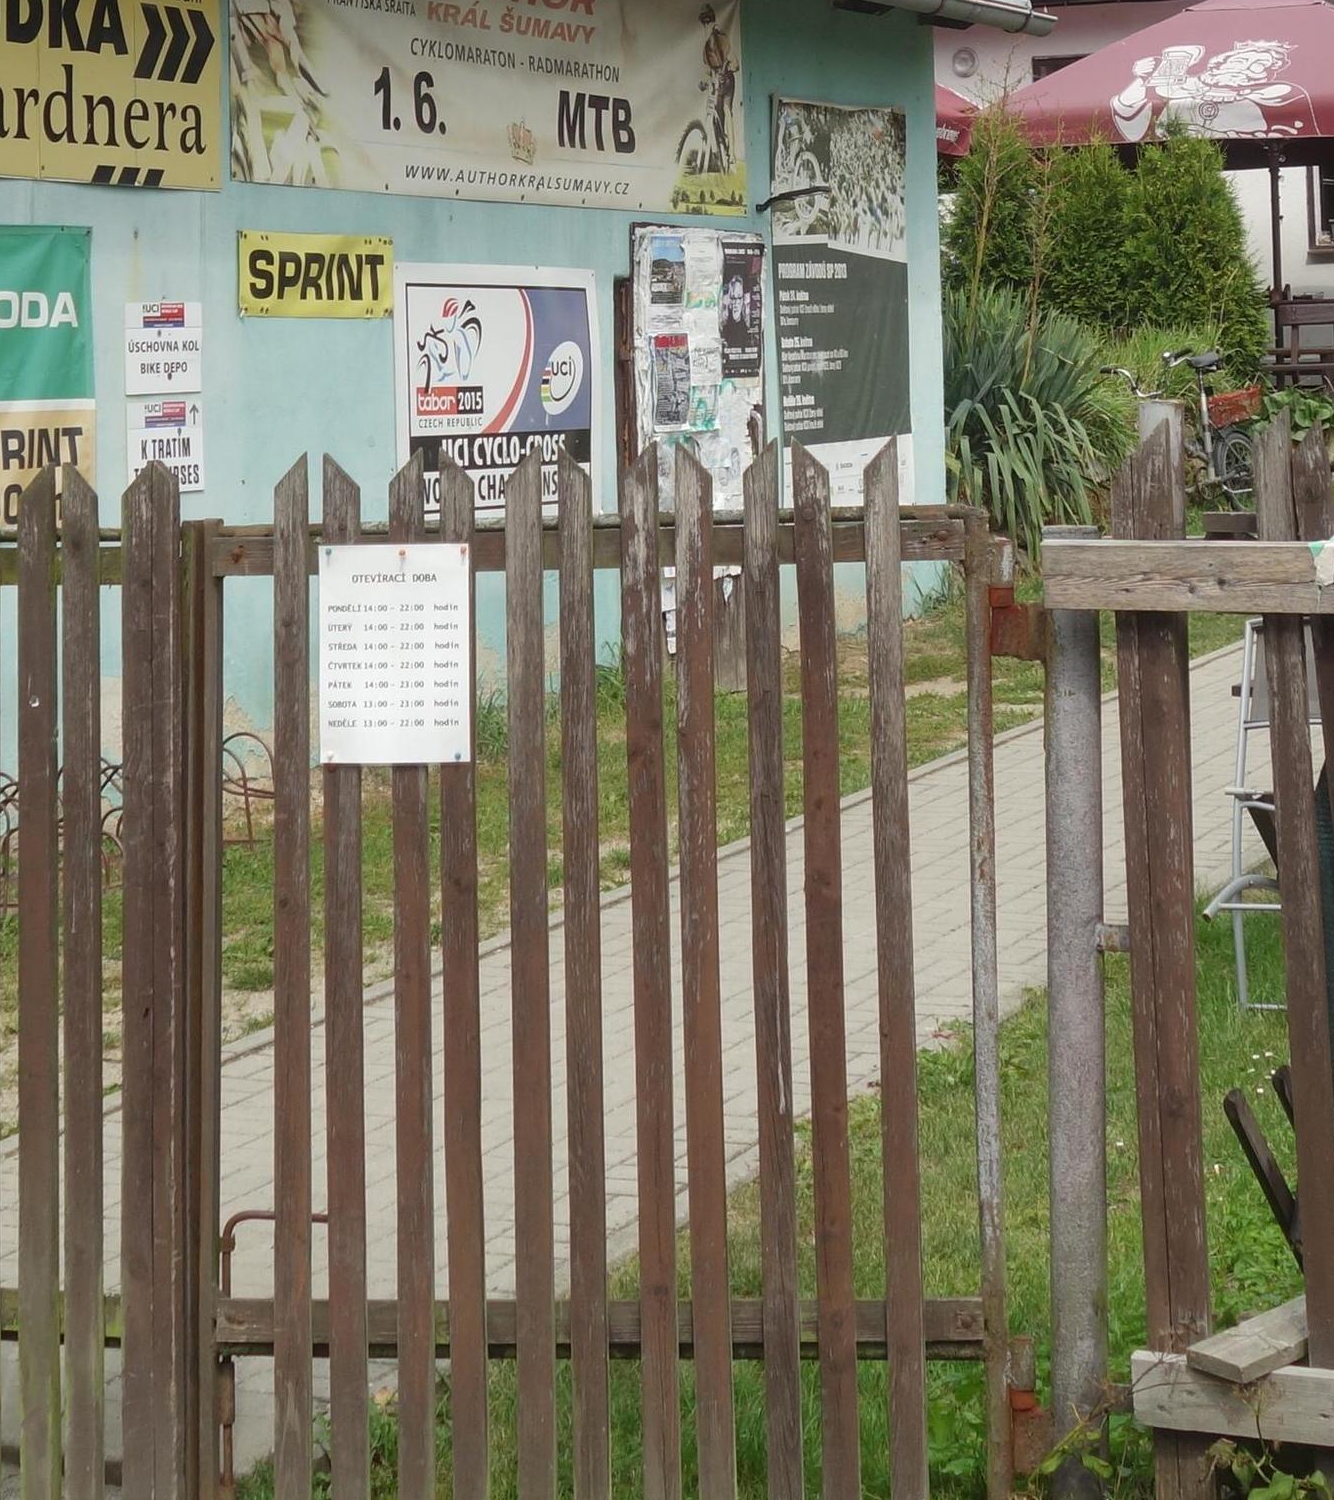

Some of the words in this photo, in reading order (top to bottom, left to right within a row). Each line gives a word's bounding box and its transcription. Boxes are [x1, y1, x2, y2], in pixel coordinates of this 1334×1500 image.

[427, 1, 491, 31] KRÁL
[499, 6, 596, 44] ŠUMAVY
[410, 38, 516, 69] CYKLOMARATON
[528, 55, 620, 83] RADMARATHON
[374, 66, 402, 131] 1.
[414, 71, 446, 136] 6.
[557, 90, 636, 153] MTB
[405, 164, 630, 195] WWW.AUTHORKRALSUMAVY.CZ
[249, 249, 385, 301] SPRINT
[128, 339, 178, 352] ÚSCHOVNA
[182, 339, 199, 351] KOL
[140, 362, 160, 374] BIKE
[163, 361, 188, 374] DEPO
[457, 391, 483, 410] 2015
[418, 418, 443, 428] CZECH
[446, 416, 483, 427] REPUBLIC
[141, 439, 148, 460] K
[152, 435, 191, 459] TRATÍM
[352, 573, 406, 584] OTEVÍRACÍ
[412, 573, 437, 583] DOBA
[328, 604, 362, 613] PONDĚLÍ
[363, 603, 387, 613] 14:00
[399, 603, 425, 612] 22:00
[434, 602, 458, 612] hodin
[364, 622, 388, 632] 14:00
[399, 622, 425, 631] 22:00
[434, 622, 458, 631] hodin
[364, 641, 388, 651] 14:00
[399, 641, 425, 650] 22:00
[435, 640, 459, 650] hodin
[364, 661, 388, 671] 14:00
[399, 661, 425, 670] 22:00
[434, 660, 459, 670] hodin
[364, 680, 388, 690] 14:00
[399, 680, 425, 689] 23:00
[434, 680, 459, 689] hodin
[328, 699, 357, 709] SOBOTA
[363, 699, 387, 709] 13:00
[399, 699, 425, 708] 23:00
[434, 698, 459, 708] hodin
[363, 718, 387, 728] 13:00
[399, 718, 425, 727] 22:00
[434, 718, 459, 727] hodin
